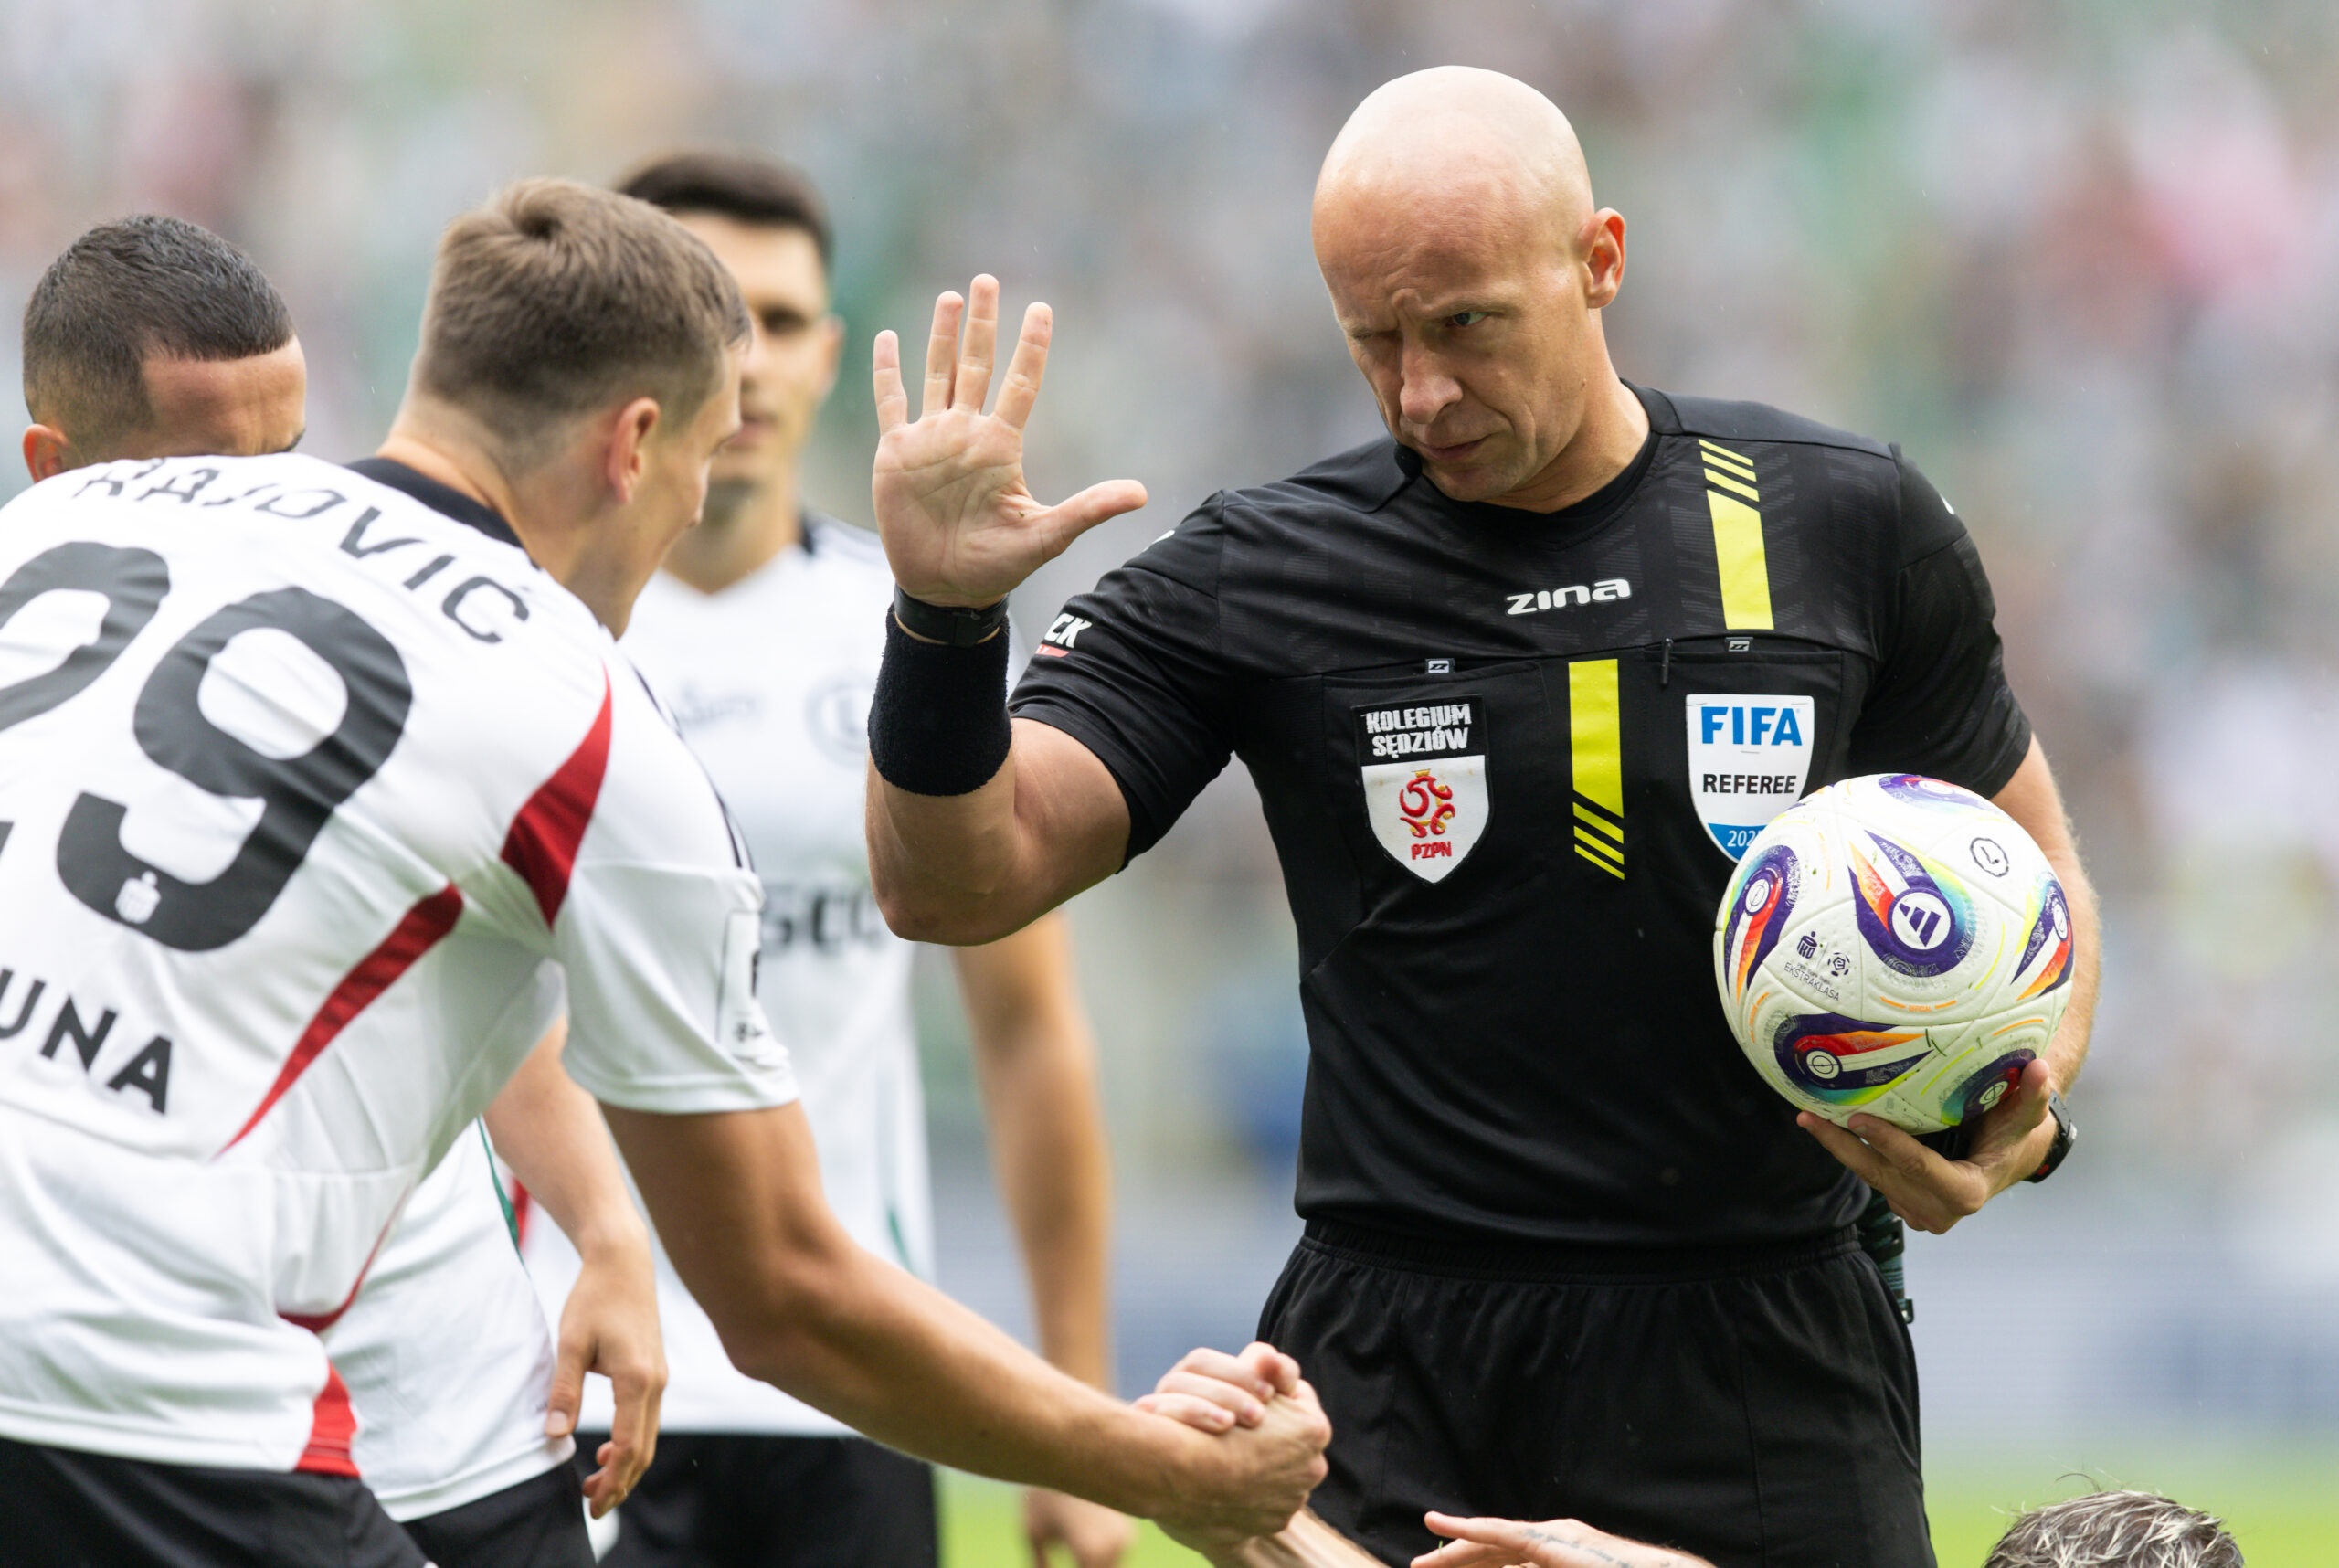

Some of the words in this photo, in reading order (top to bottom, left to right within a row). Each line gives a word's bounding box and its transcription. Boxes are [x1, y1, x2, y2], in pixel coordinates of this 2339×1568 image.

[1365, 704, 1472, 733] KOLEGIUM
[1701, 706, 1803, 746] FIFA
[1372, 727, 1468, 758] SĘDZIÓW
[1702, 774, 1797, 794] REFEREE
[1411, 841, 1452, 860] PZPN
[1727, 830, 1764, 847] 202
[1783, 962, 1839, 1001] EKSTRAKLASA
